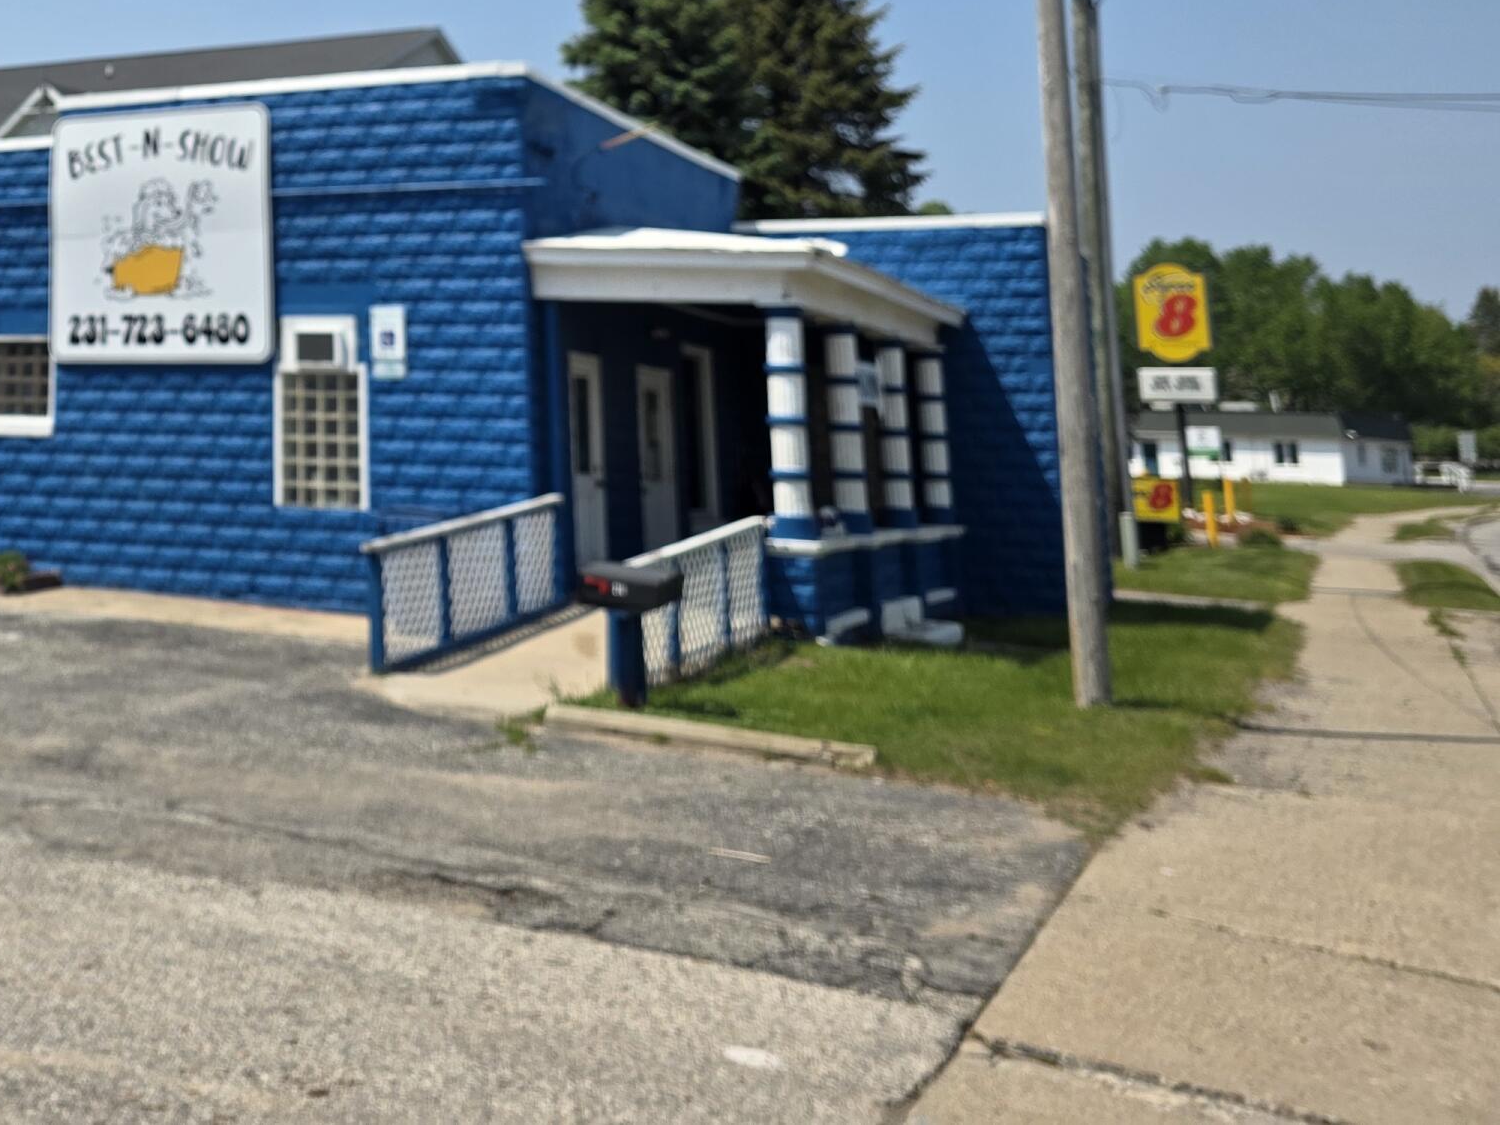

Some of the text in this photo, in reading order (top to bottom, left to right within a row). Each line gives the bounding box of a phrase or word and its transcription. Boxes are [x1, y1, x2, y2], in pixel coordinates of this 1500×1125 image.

[67, 127, 256, 180] BEST-N-SHOW
[68, 312, 251, 346] 231-723-6480
[1154, 295, 1198, 338] 8
[1149, 483, 1173, 510] 8
